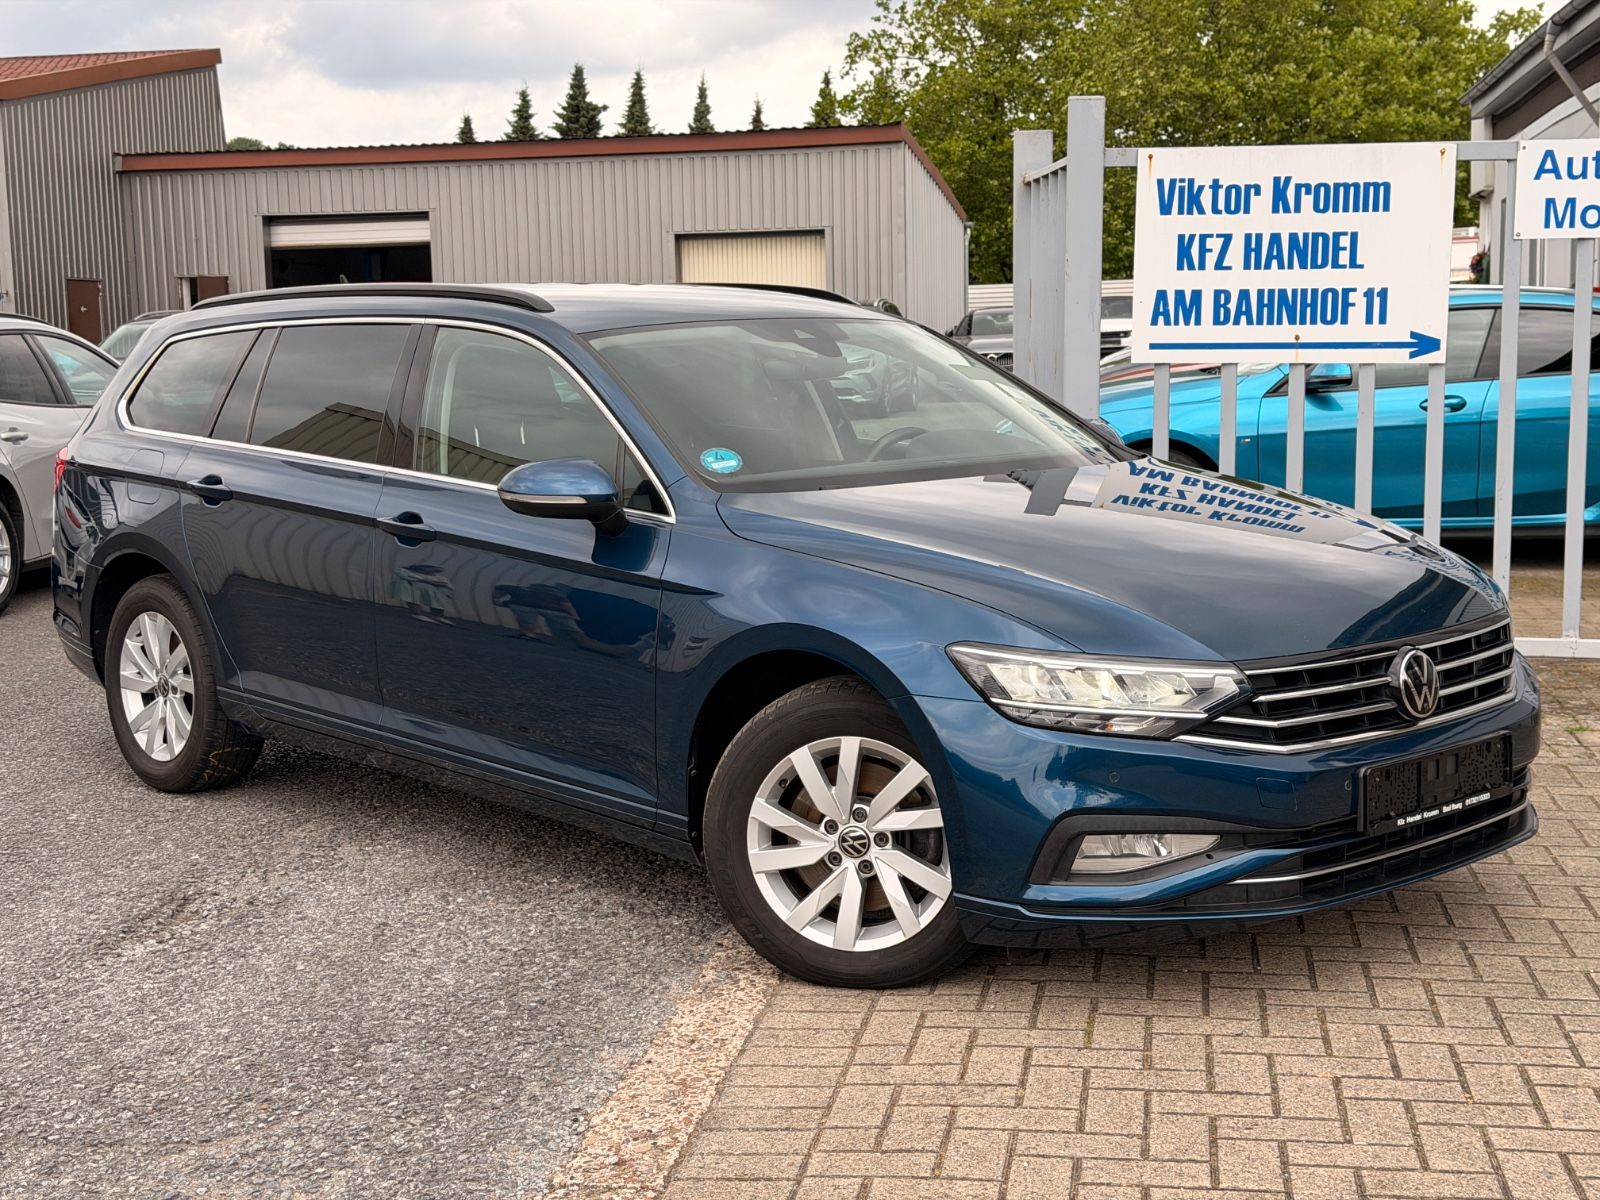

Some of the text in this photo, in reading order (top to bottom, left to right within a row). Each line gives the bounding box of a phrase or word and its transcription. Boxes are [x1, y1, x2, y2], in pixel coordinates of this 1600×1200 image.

[1156, 175, 1391, 216] Viktor Kromm
[1543, 197, 1600, 229] Mo
[1176, 231, 1365, 271] KFZ HANDEL
[1150, 287, 1389, 326] AM BAHNHOF 11
